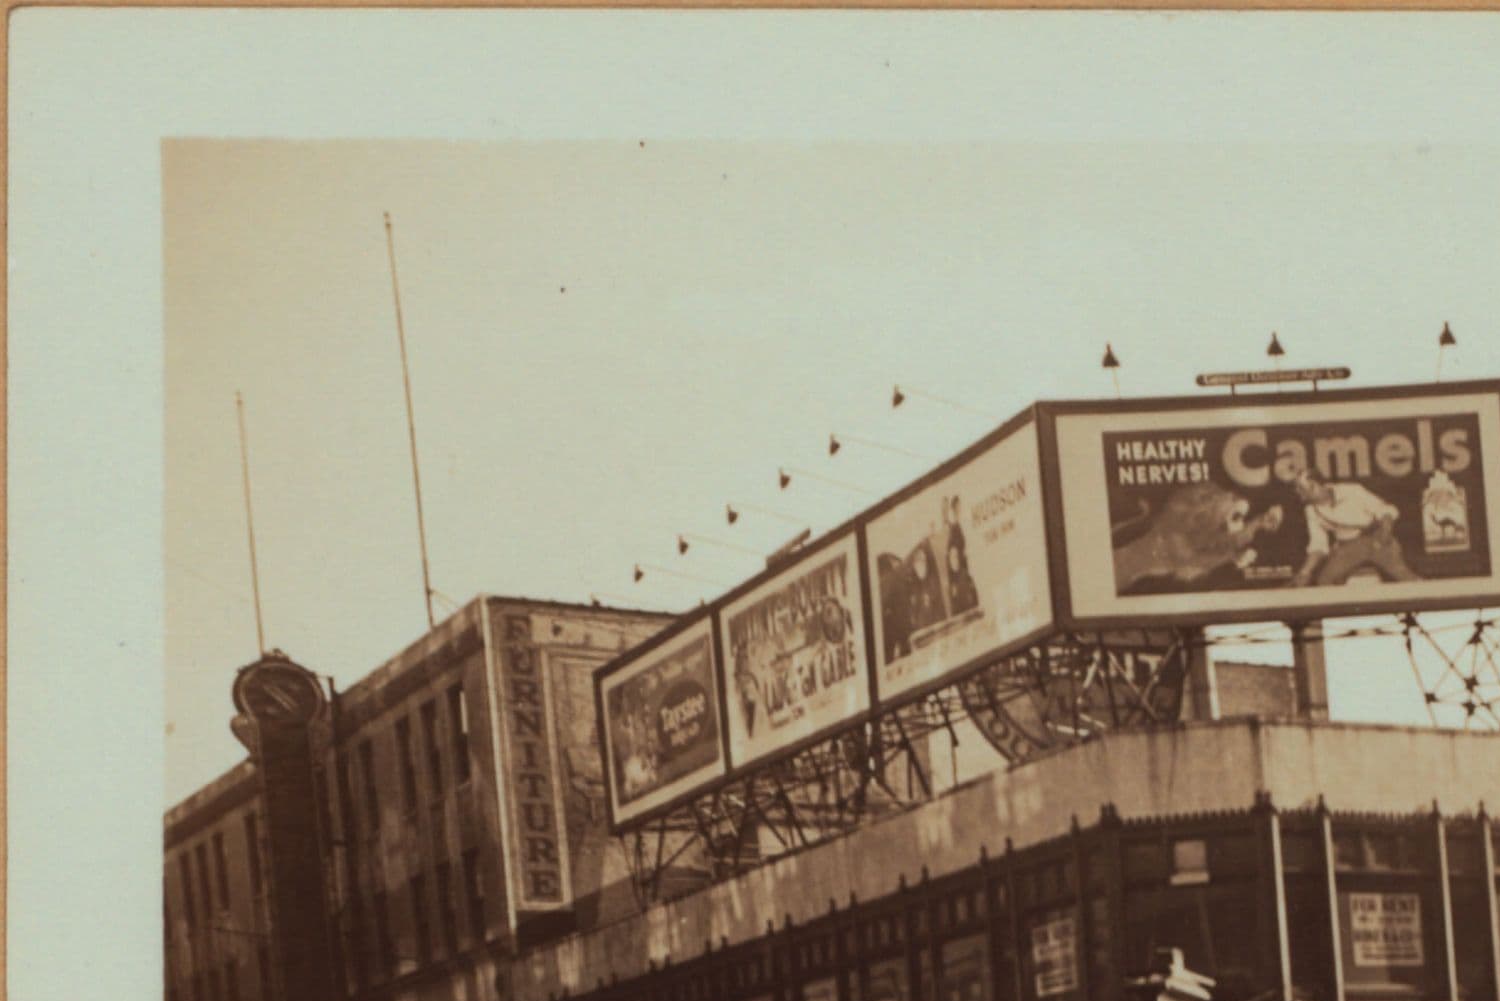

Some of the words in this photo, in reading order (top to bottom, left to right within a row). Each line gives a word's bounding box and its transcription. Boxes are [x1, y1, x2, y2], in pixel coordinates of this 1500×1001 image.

[1115, 438, 1207, 462] HEALTHY
[1118, 460, 1209, 487] NERVES!
[1222, 420, 1472, 487] Camels
[971, 476, 1026, 529] HUDSON
[504, 614, 560, 900] FURNITURE
